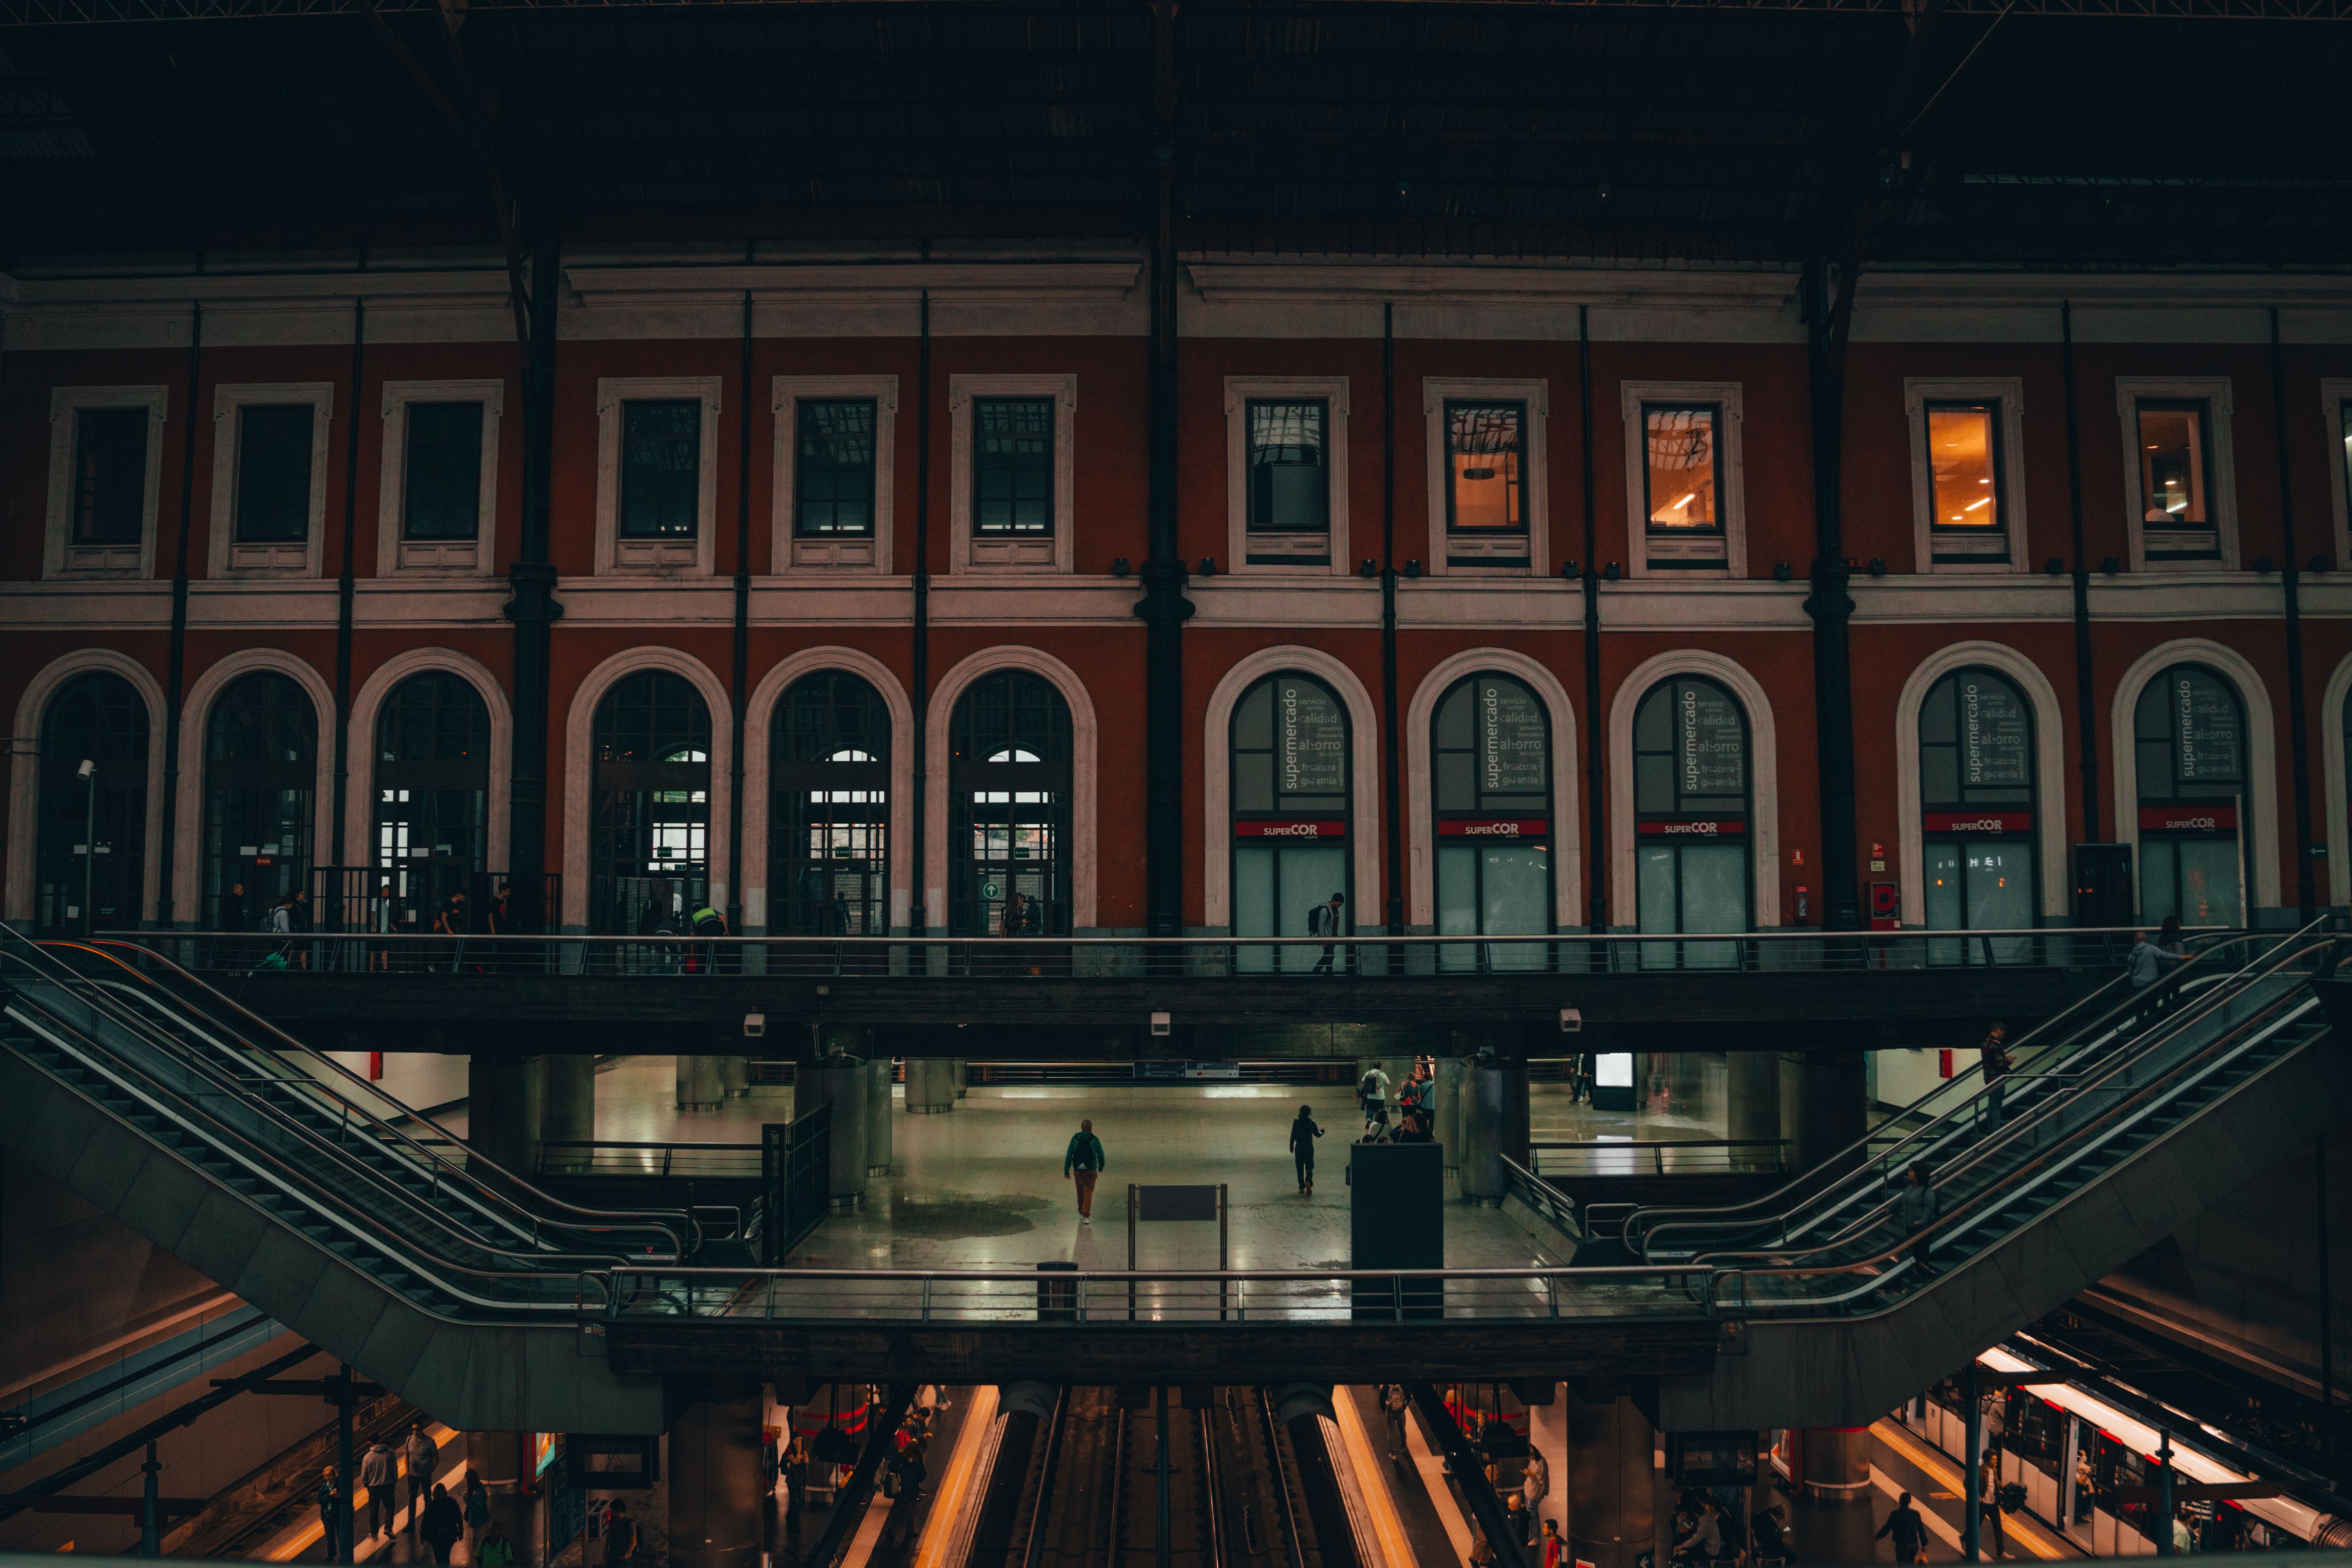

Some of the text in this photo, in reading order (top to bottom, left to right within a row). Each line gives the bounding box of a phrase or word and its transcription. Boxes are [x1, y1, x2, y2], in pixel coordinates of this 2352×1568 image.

[1298, 713, 1337, 723] calidad
[1500, 712, 1538, 722] calidad
[1980, 708, 2016, 718] calidad
[1698, 715, 1735, 725] calidad
[1964, 685, 1983, 782] supermercado
[2177, 680, 2197, 777] supermercado
[1282, 689, 1300, 789] supermercado
[1483, 688, 1502, 788] supermercado
[1682, 691, 1700, 790] supermercado
[1465, 823, 1519, 834] SUPERCOR
[1665, 822, 1717, 833] SUPERCOR
[1952, 820, 2003, 830] SUPERCOR
[2166, 818, 2215, 828] SUPERCOR
[1264, 824, 1318, 835] SUPERCOR
